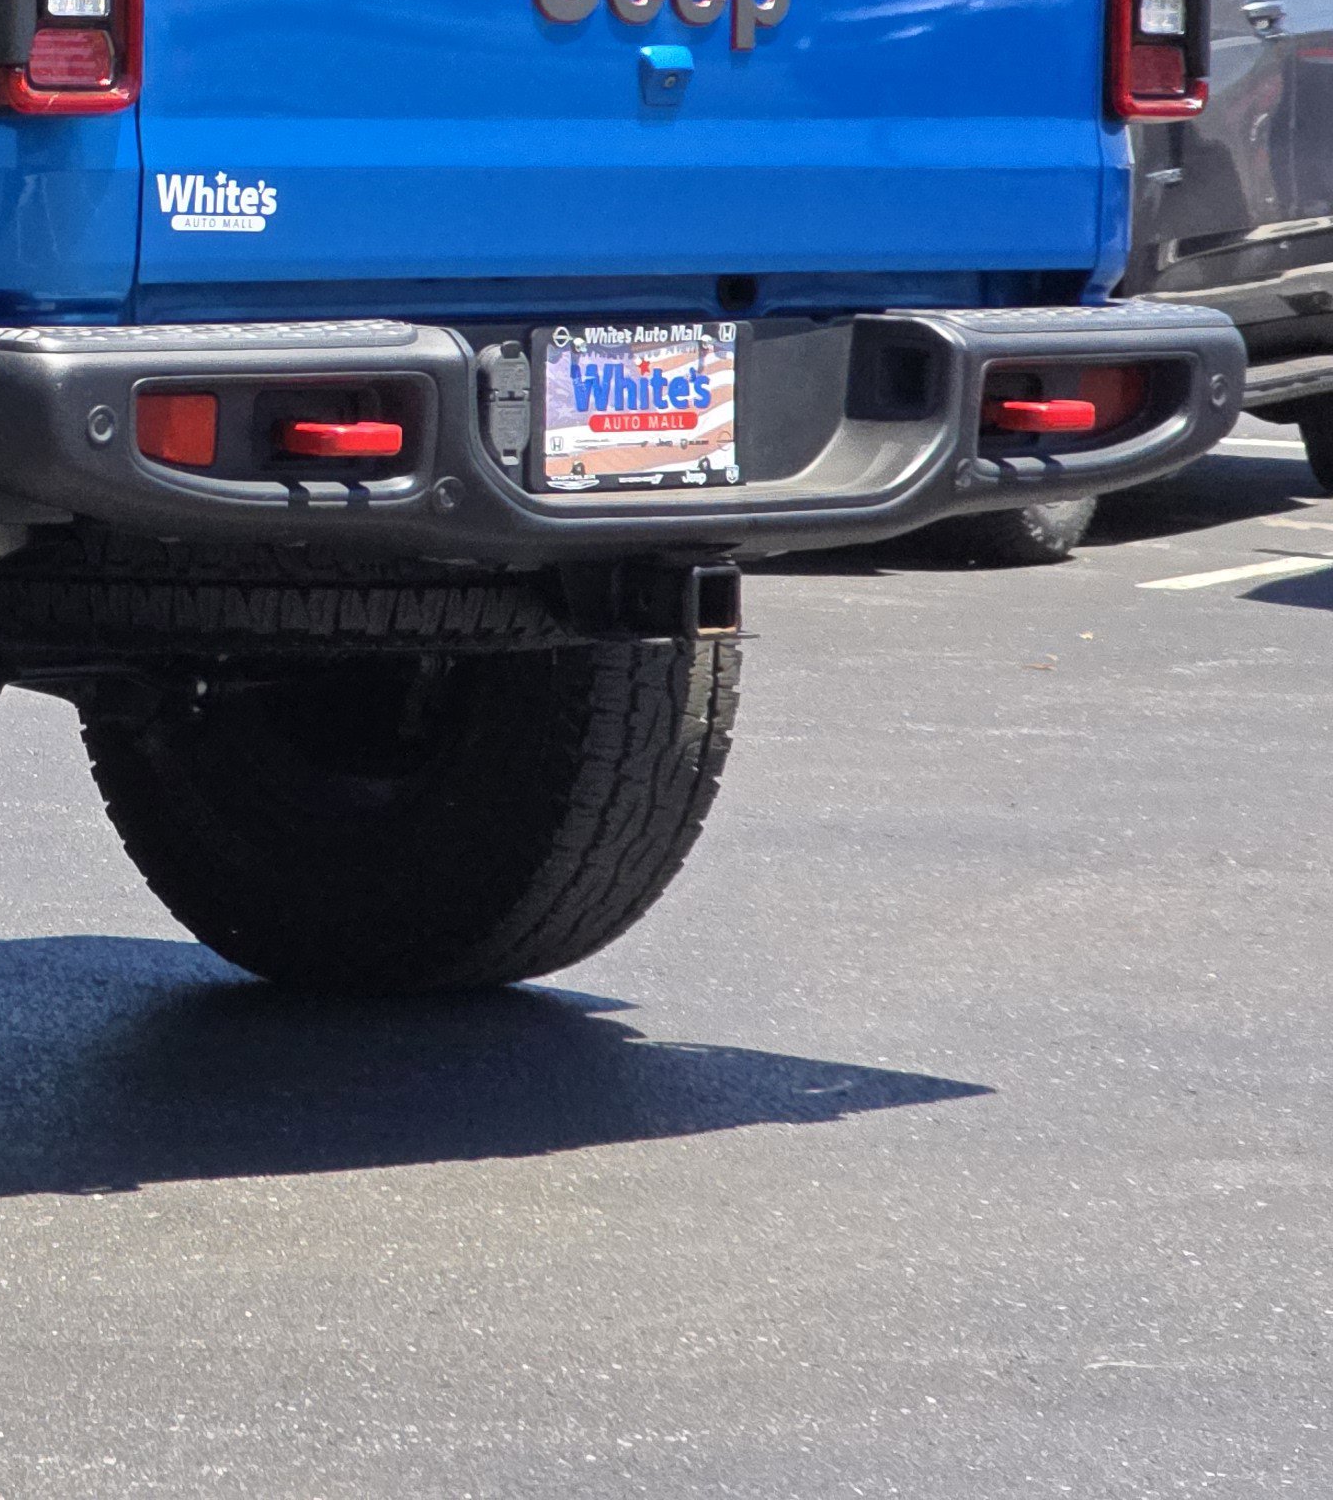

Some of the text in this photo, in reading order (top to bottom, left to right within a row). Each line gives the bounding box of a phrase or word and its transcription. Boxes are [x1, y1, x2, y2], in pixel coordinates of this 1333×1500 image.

[156, 171, 277, 215] White's
[184, 217, 253, 229] AUTO MALL
[634, 326, 668, 343] Auto
[671, 324, 703, 342] Mall
[570, 358, 712, 413] White's
[603, 415, 684, 431] AUTO MALL
